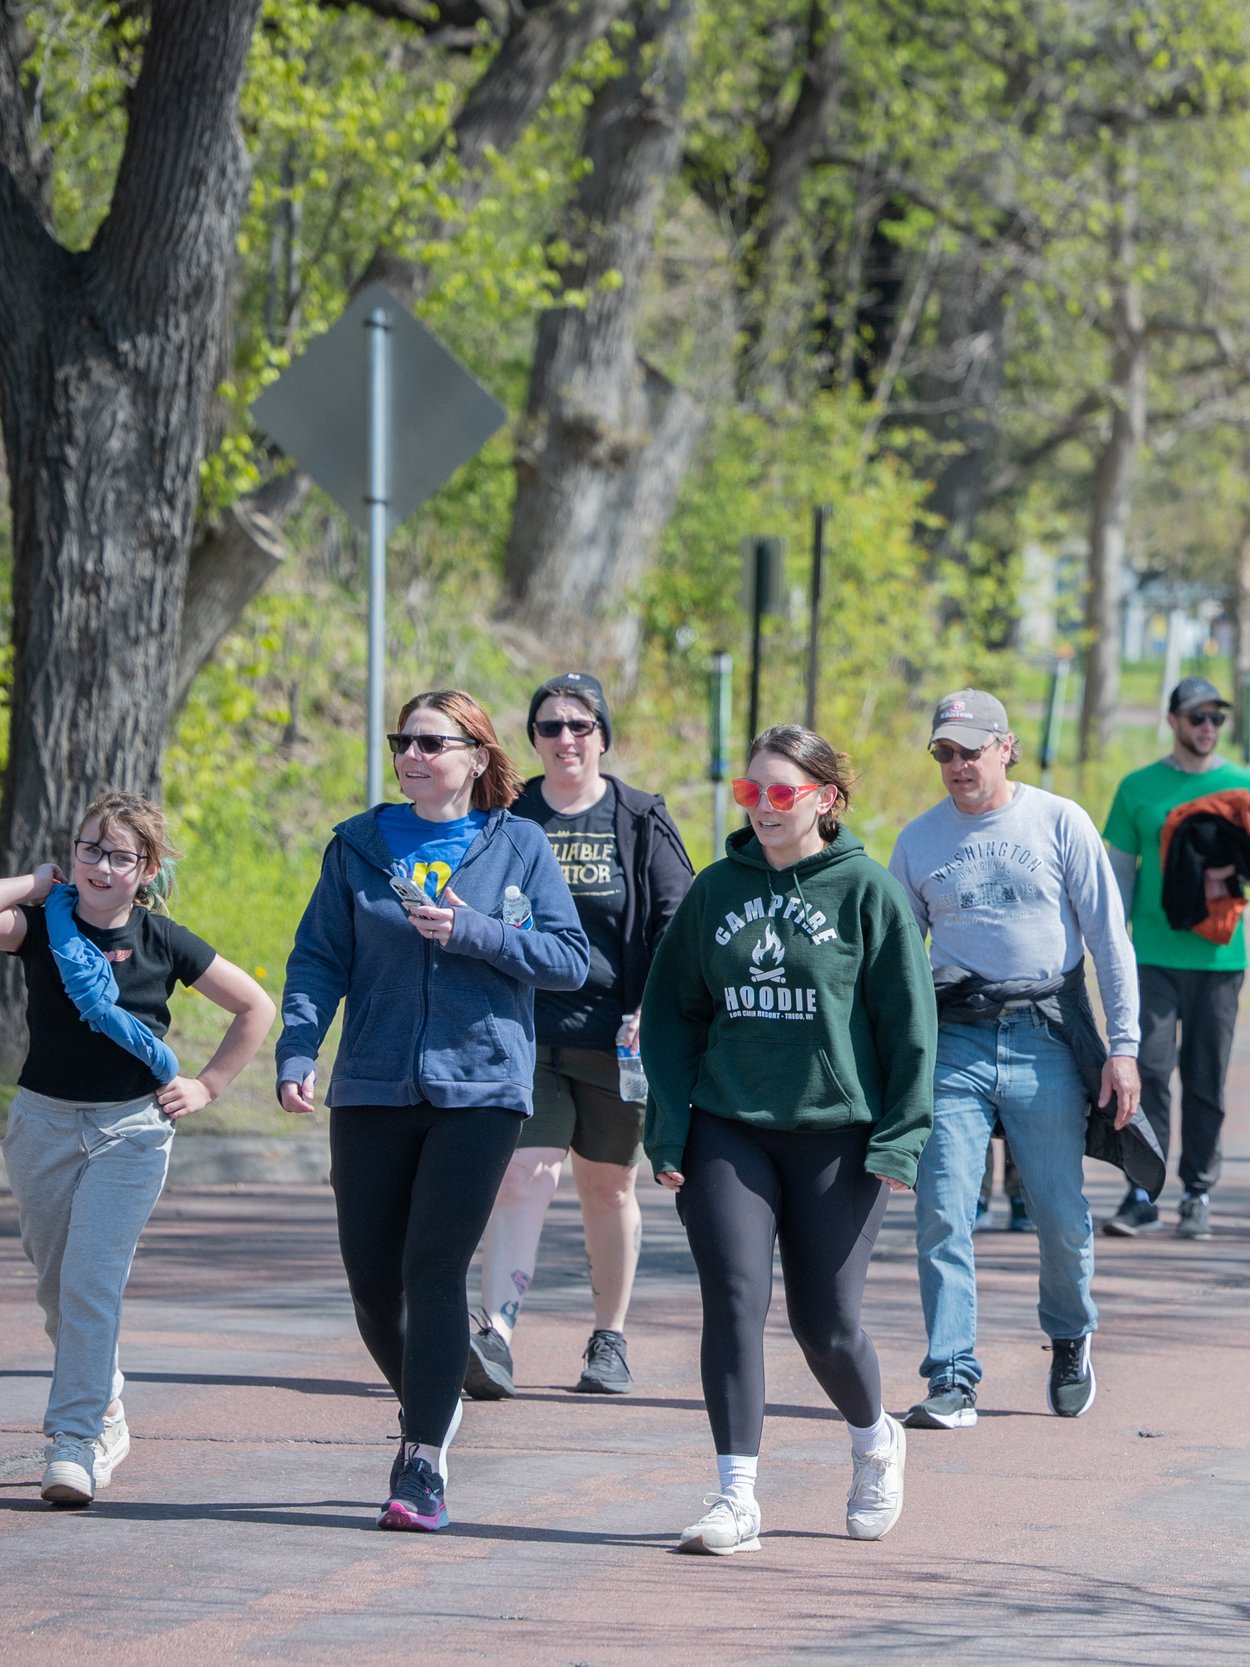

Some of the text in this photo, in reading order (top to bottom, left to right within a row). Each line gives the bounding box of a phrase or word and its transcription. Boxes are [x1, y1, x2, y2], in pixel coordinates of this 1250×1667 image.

[551, 842, 614, 862] LIABLE
[931, 841, 1042, 884] WASHINGTON
[560, 863, 612, 884] ATOR
[959, 860, 1010, 880] ORIGINA
[715, 895, 838, 946] CAMPFIRE
[724, 985, 817, 1012] HOODIE
[757, 1011, 780, 1019] RESORT
